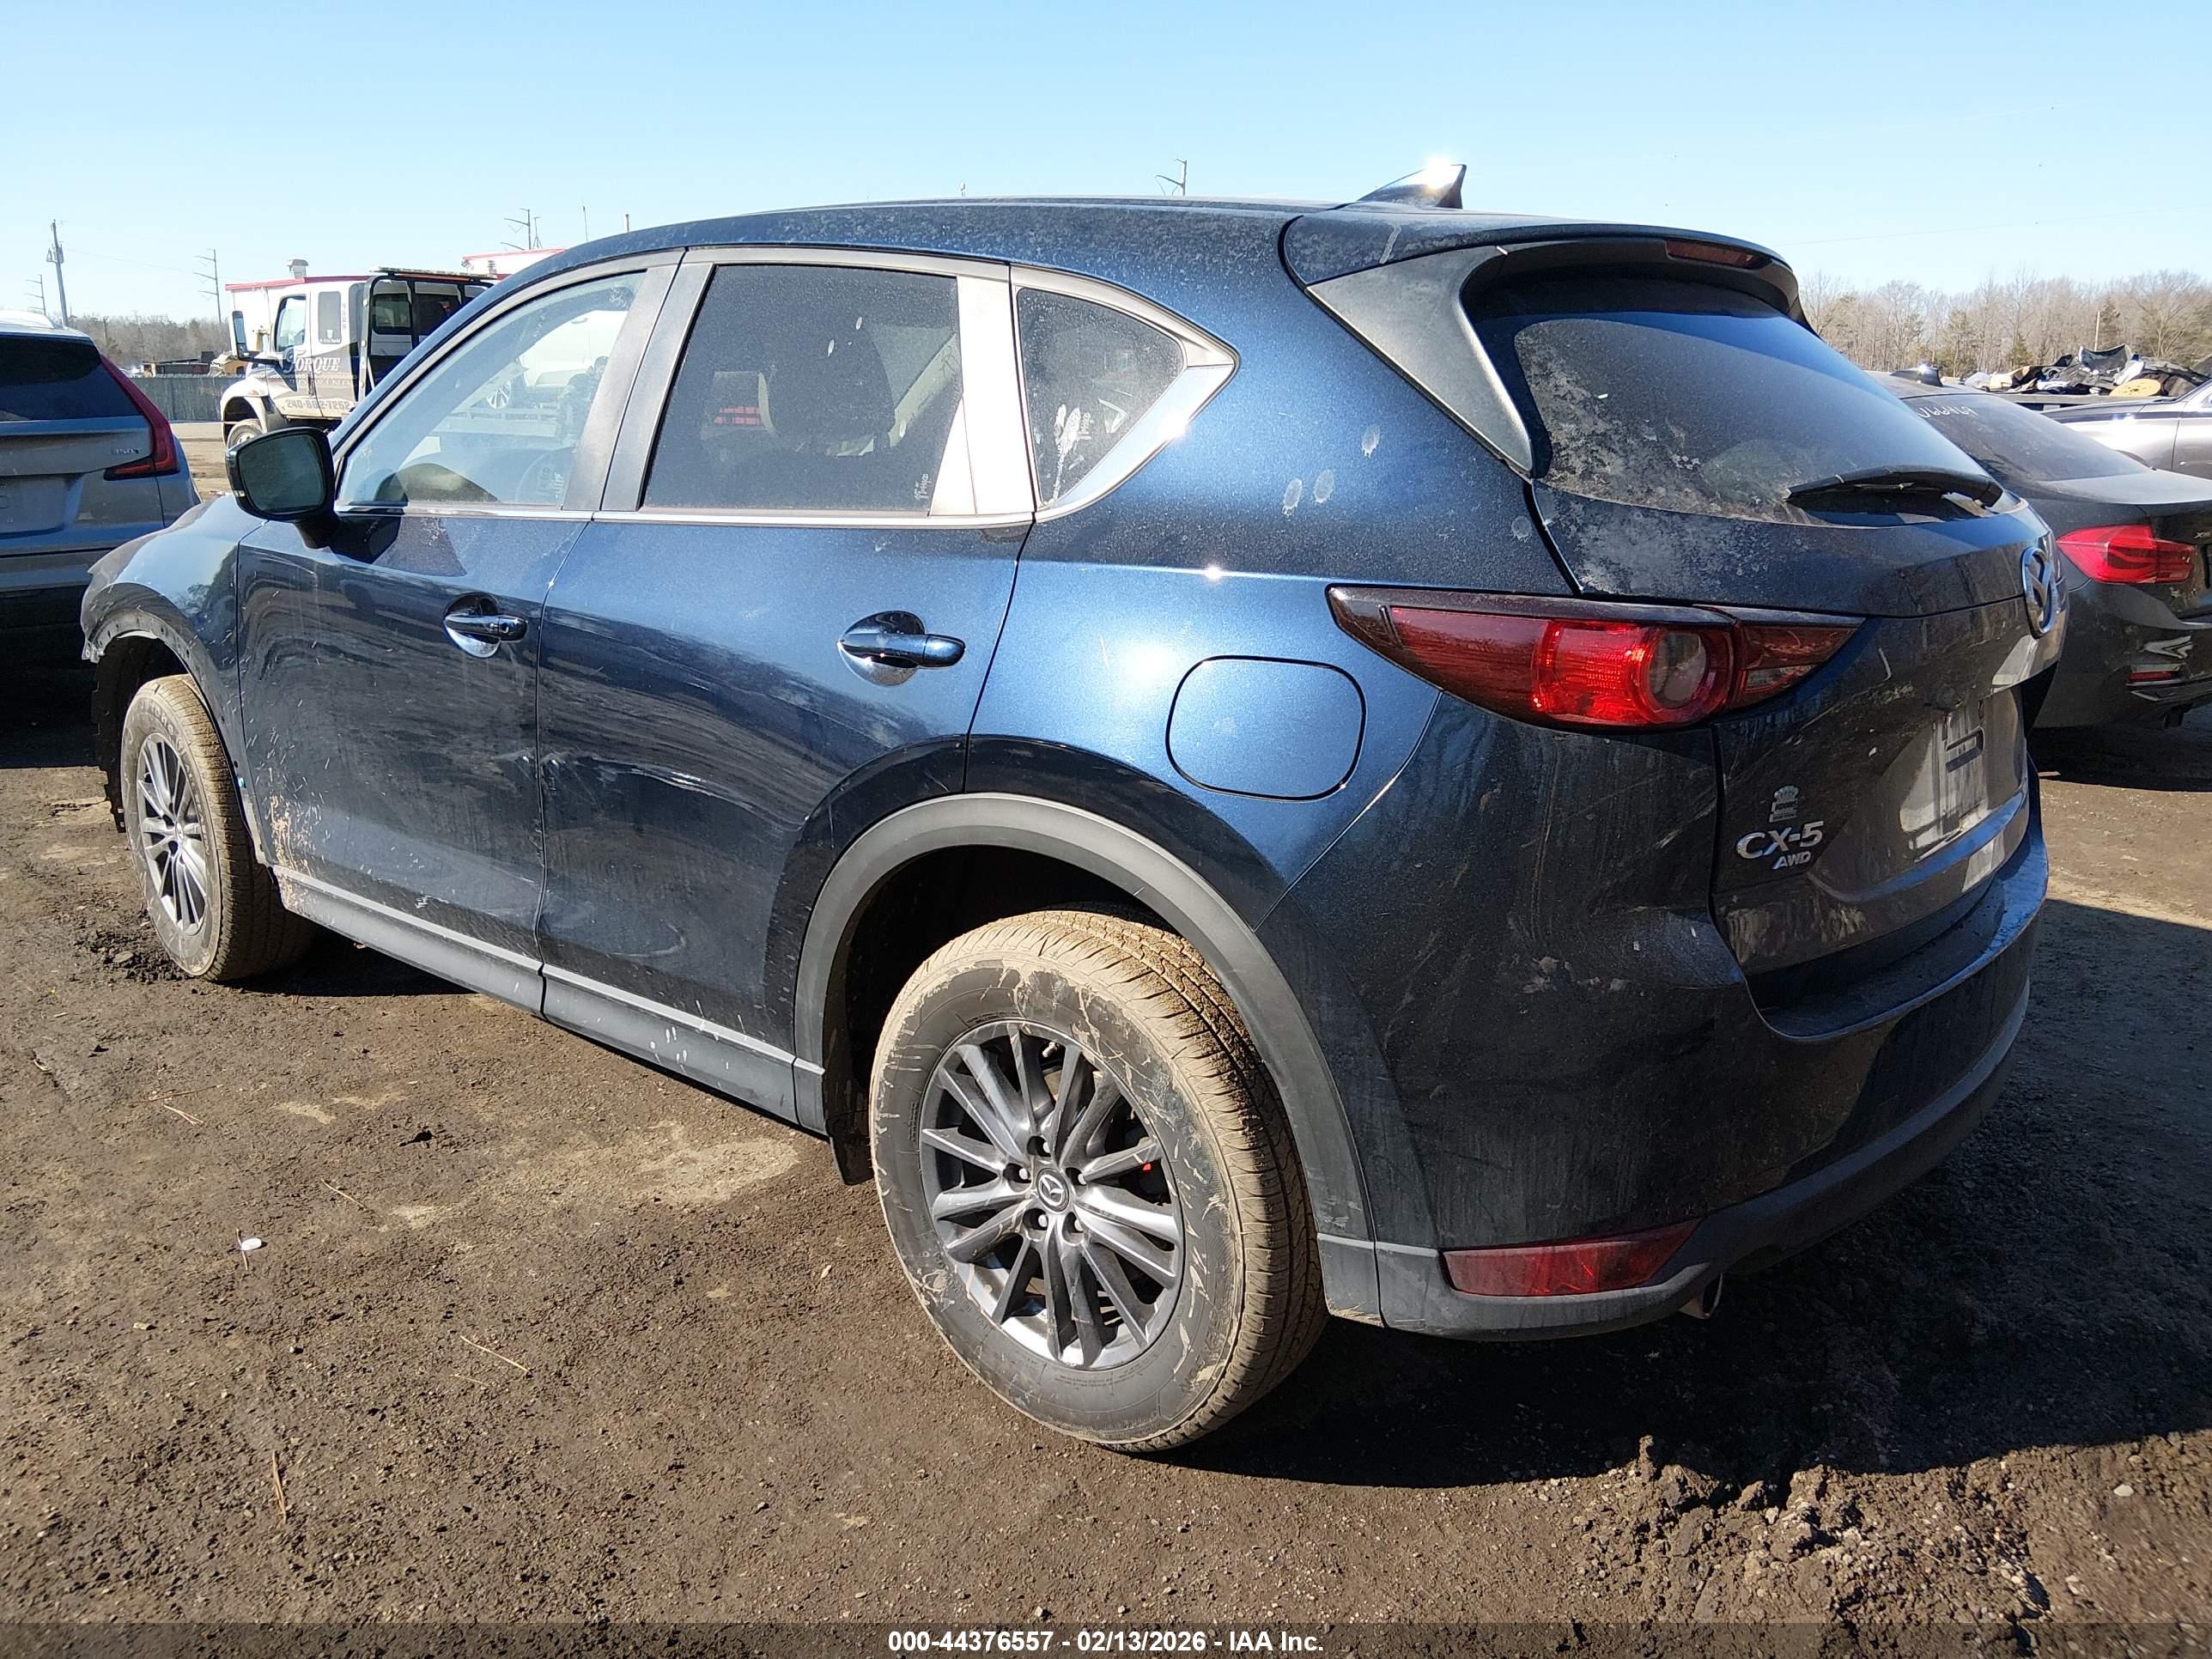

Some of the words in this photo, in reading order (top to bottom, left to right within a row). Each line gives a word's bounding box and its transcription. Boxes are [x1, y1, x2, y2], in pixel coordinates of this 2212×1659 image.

[283, 347, 341, 374] TORQUE
[1736, 821, 1824, 859] CX-5
[1771, 851, 1812, 870] AWD
